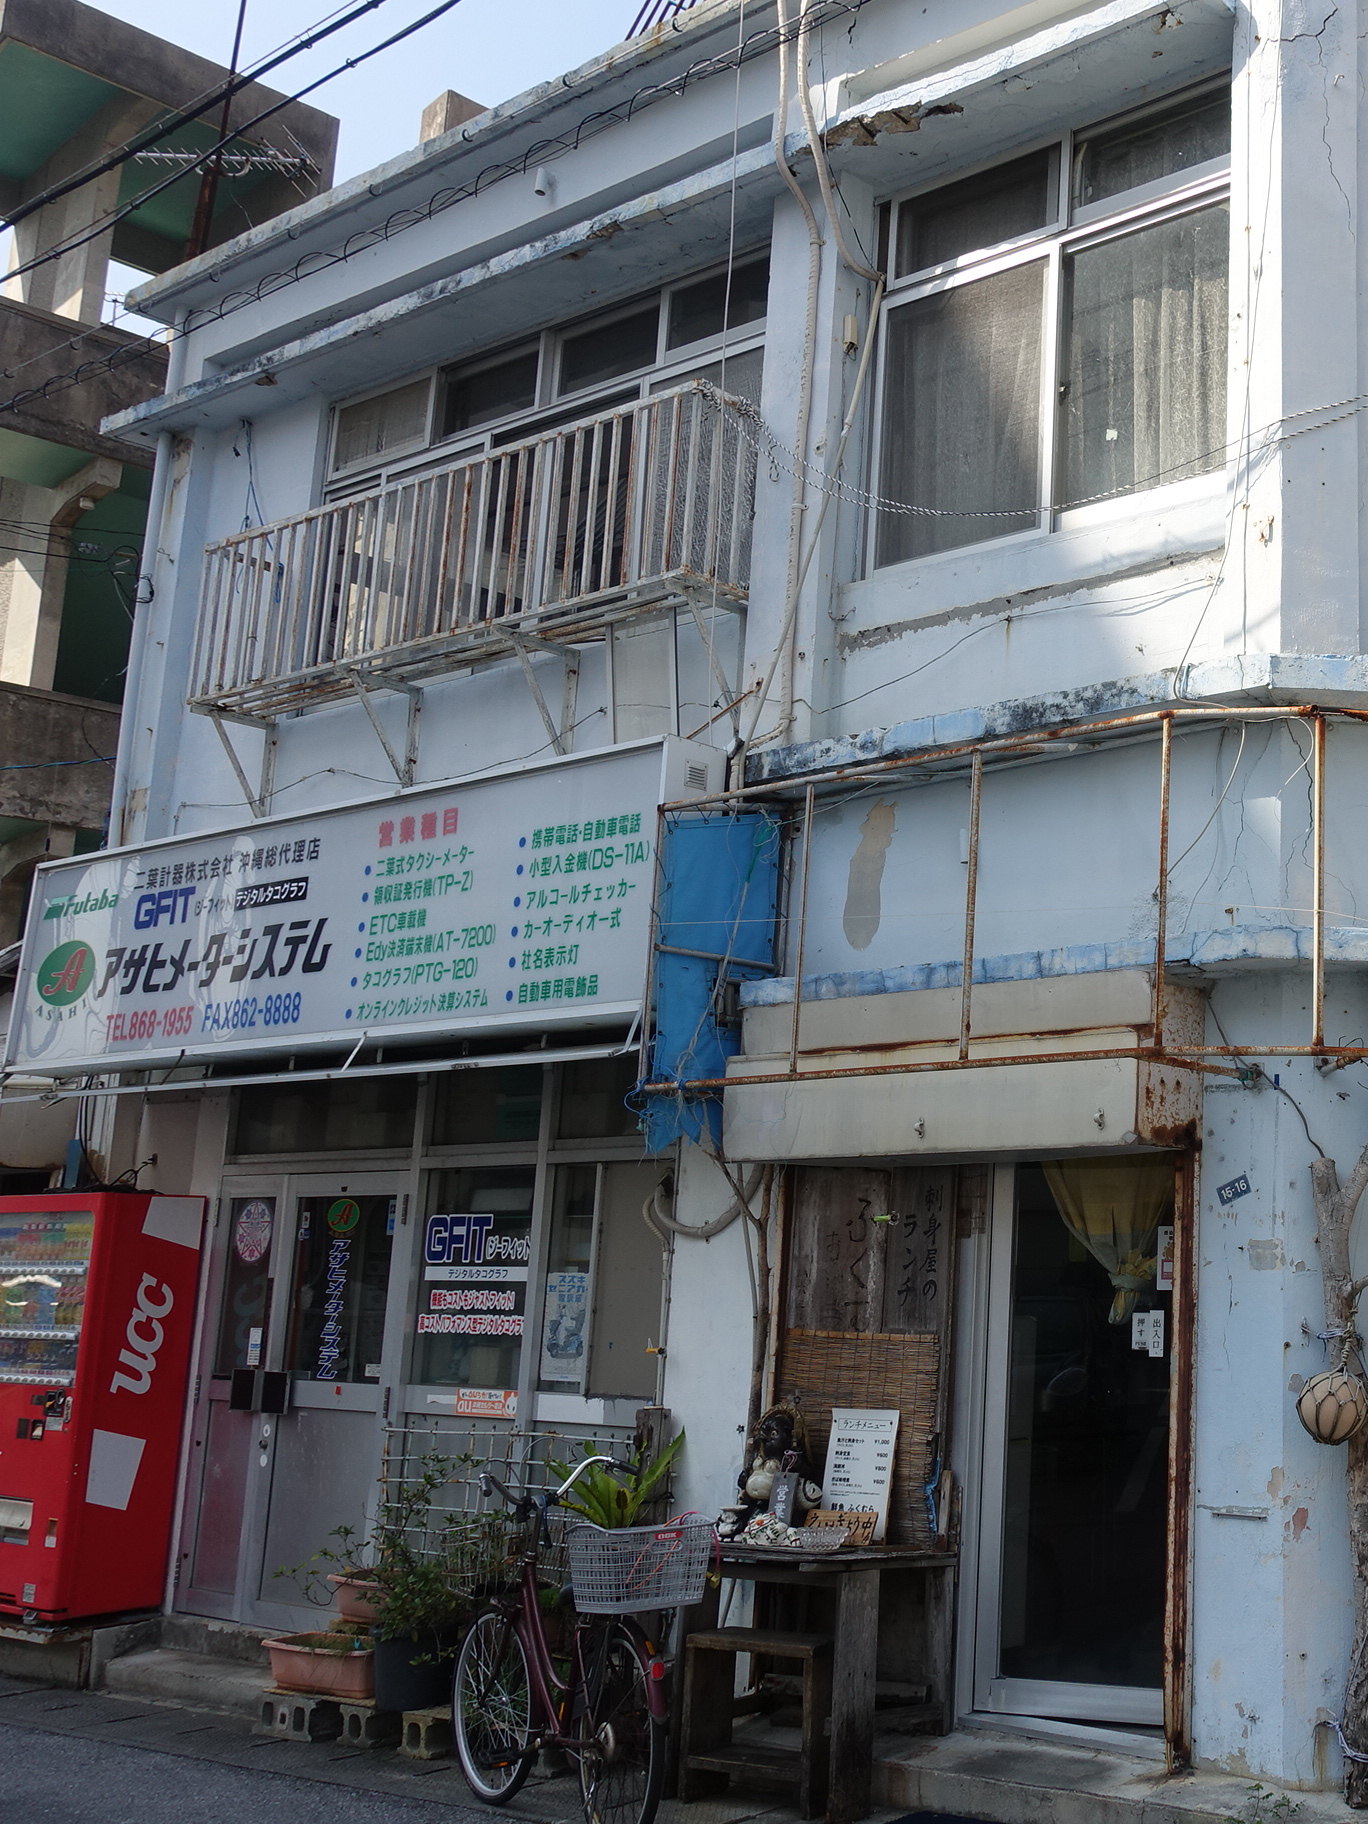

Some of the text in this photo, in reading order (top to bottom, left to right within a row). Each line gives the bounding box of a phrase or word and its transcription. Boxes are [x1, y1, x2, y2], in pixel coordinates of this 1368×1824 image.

[379, 807, 459, 848] 営業種目
[133, 837, 321, 891] 二葉計器株式会社 沖縄総代理店
[375, 845, 475, 877] 二葉式タクシーメーター
[528, 840, 650, 878] 小型入金機(DS-11A)
[62, 888, 120, 918] Futaba
[133, 885, 197, 930] GFIT
[235, 879, 308, 909] デジタルタコグラフ
[373, 870, 474, 906] 領収証発行機(TP-Z)
[525, 878, 636, 910] アルコールチェッカー
[368, 908, 427, 936] ETC車載機
[523, 907, 622, 939] カーオーディオ一式
[97, 917, 333, 998] アサヒメーターシステム
[361, 957, 478, 990] タコグラフ(PTG-120)
[521, 944, 580, 971] 社名表示灯
[517, 974, 599, 1005] 自動車用電飾品
[105, 991, 302, 1042] TEL868-1955 FAX862-8888
[1220, 1178, 1248, 1200] 15-16
[425, 1213, 494, 1263] GFIT
[919, 1184, 943, 1301] 刺身屋の
[447, 1269, 509, 1279] デジタルタコグラフ
[897, 1213, 918, 1307] ランチ
[558, 1275, 586, 1284] スズキ
[316, 1239, 351, 1379] アサヒメーターシステム
[1137, 1317, 1146, 1338] 押す
[1152, 1317, 1162, 1350] 出入口
[843, 1420, 887, 1430] ランチメニュー
[774, 1485, 789, 1519] 営業
